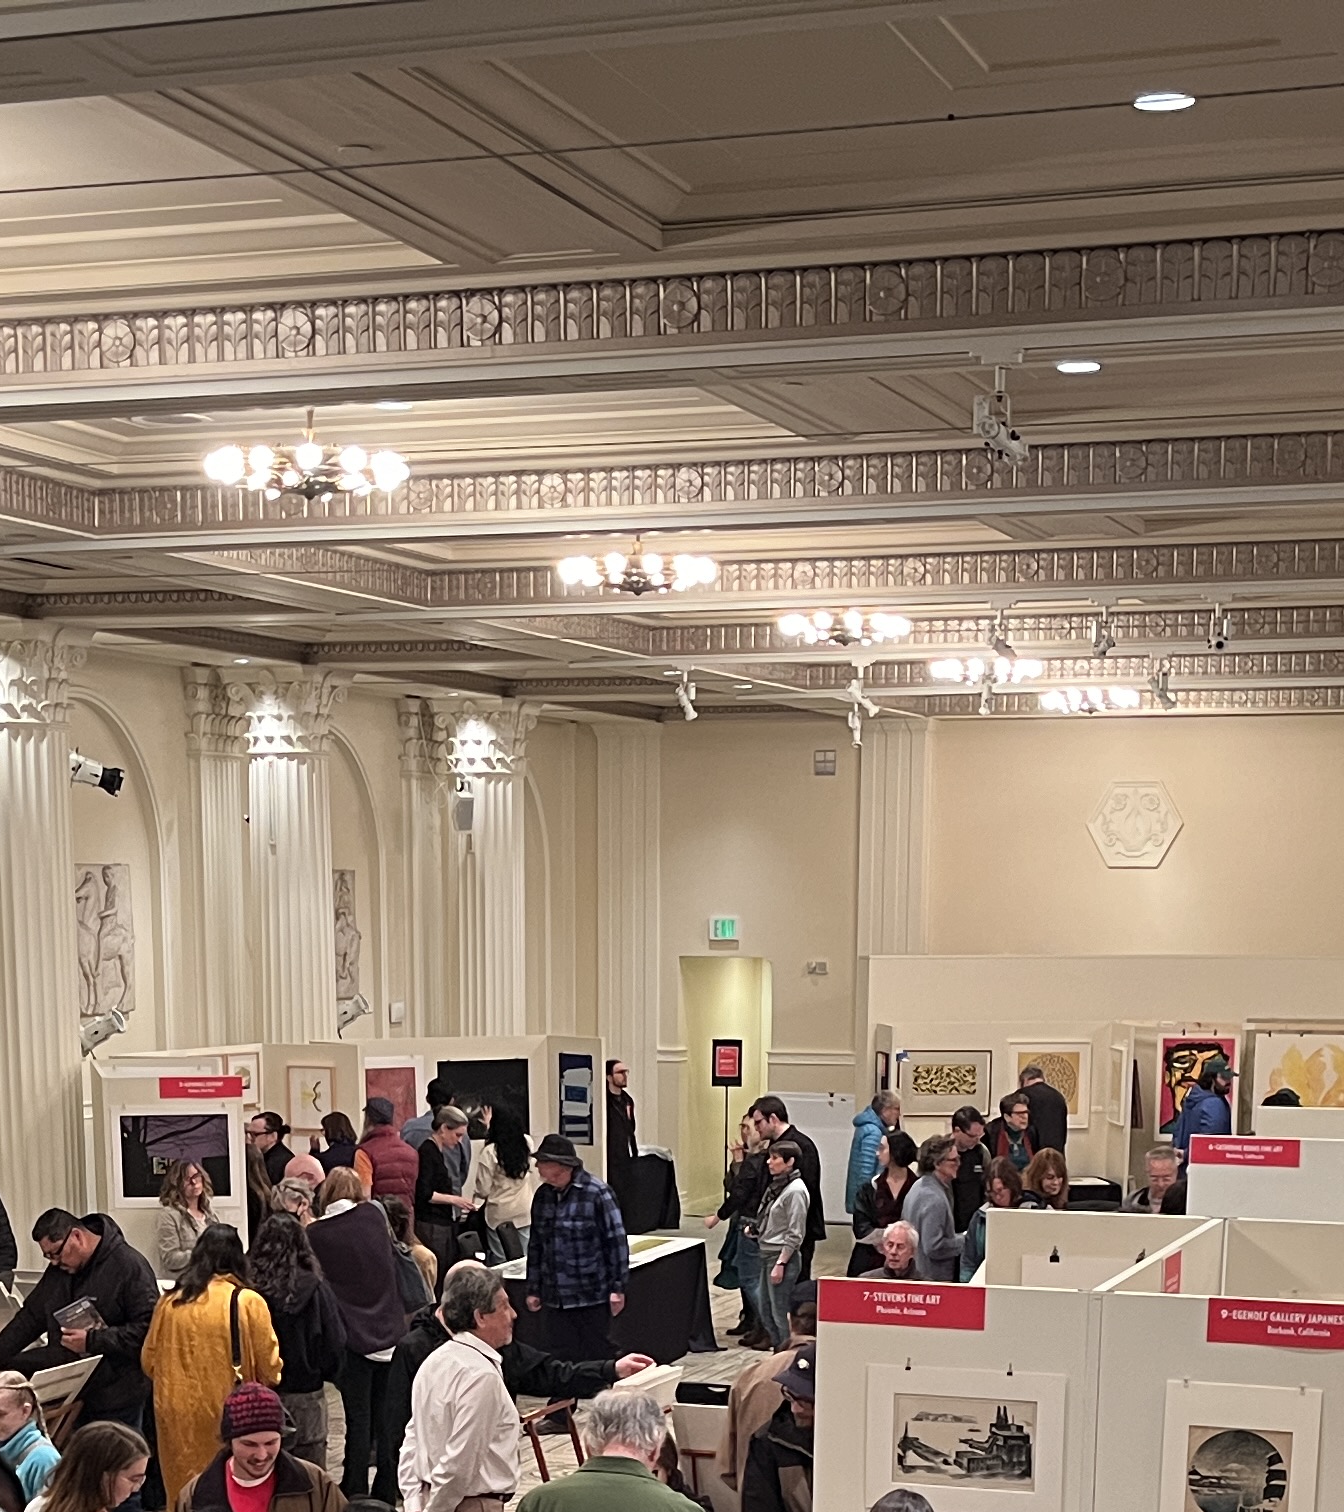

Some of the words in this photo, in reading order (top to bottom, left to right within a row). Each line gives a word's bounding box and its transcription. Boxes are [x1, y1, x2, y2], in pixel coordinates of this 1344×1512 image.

[907, 1293, 924, 1304] FINE
[925, 1294, 941, 1305] ART
[1269, 1311, 1306, 1324] GALLERY
[1297, 1327, 1331, 1337] California
